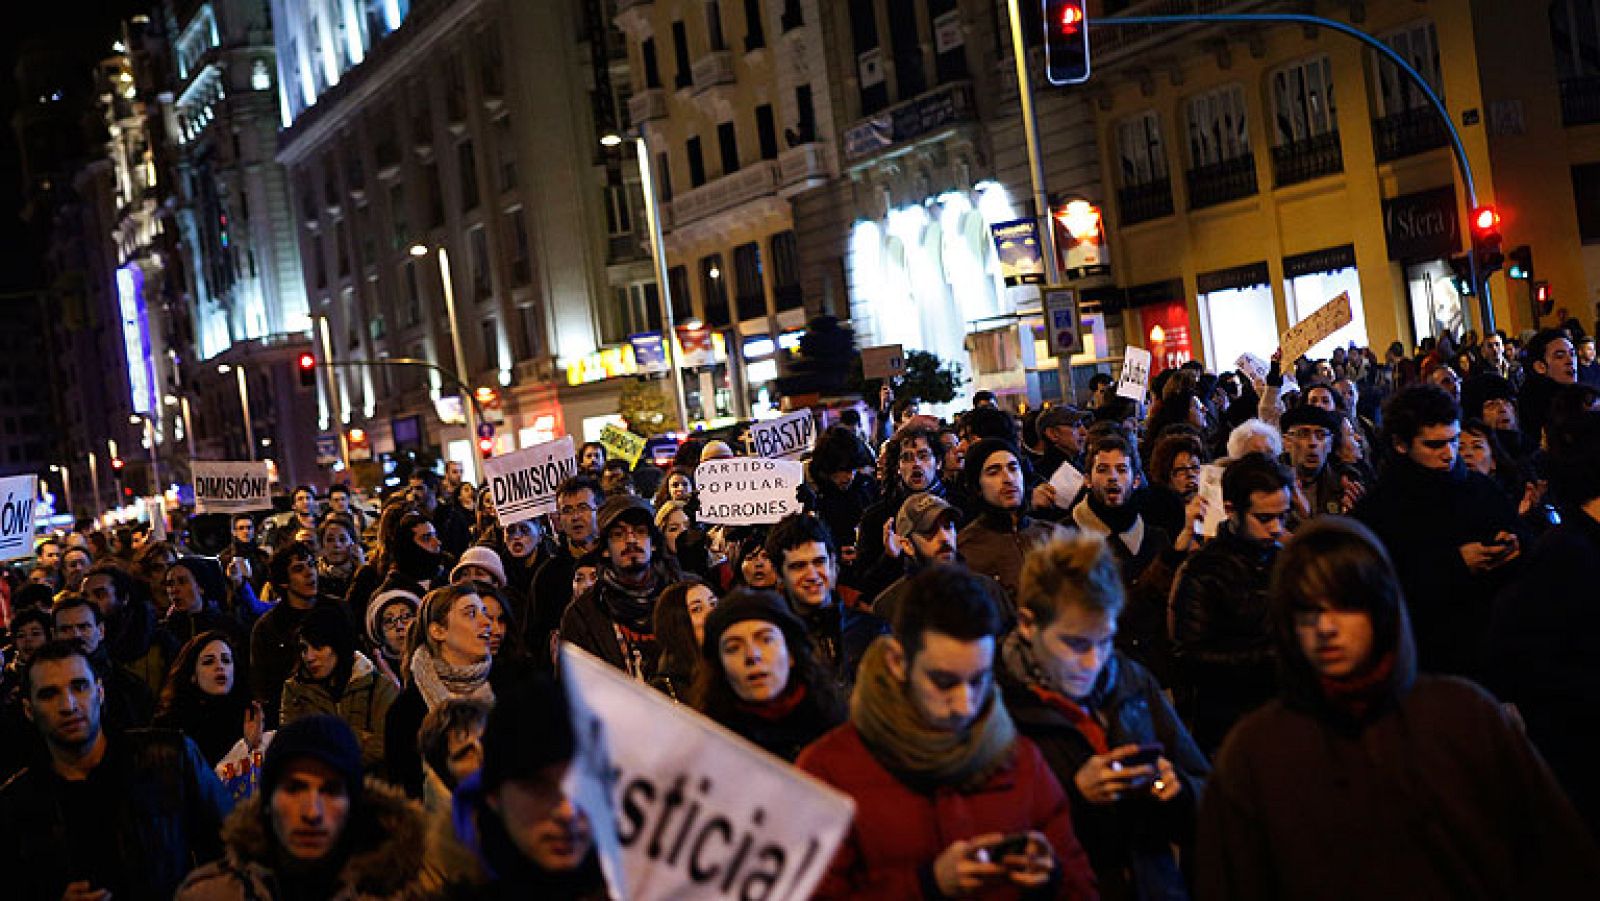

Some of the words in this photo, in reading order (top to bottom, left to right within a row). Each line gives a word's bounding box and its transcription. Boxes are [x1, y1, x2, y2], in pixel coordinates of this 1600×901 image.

[697, 460, 775, 475] PARTIDO
[195, 472, 267, 499] DIMISIÓN!
[699, 500, 788, 517] LADRONES
